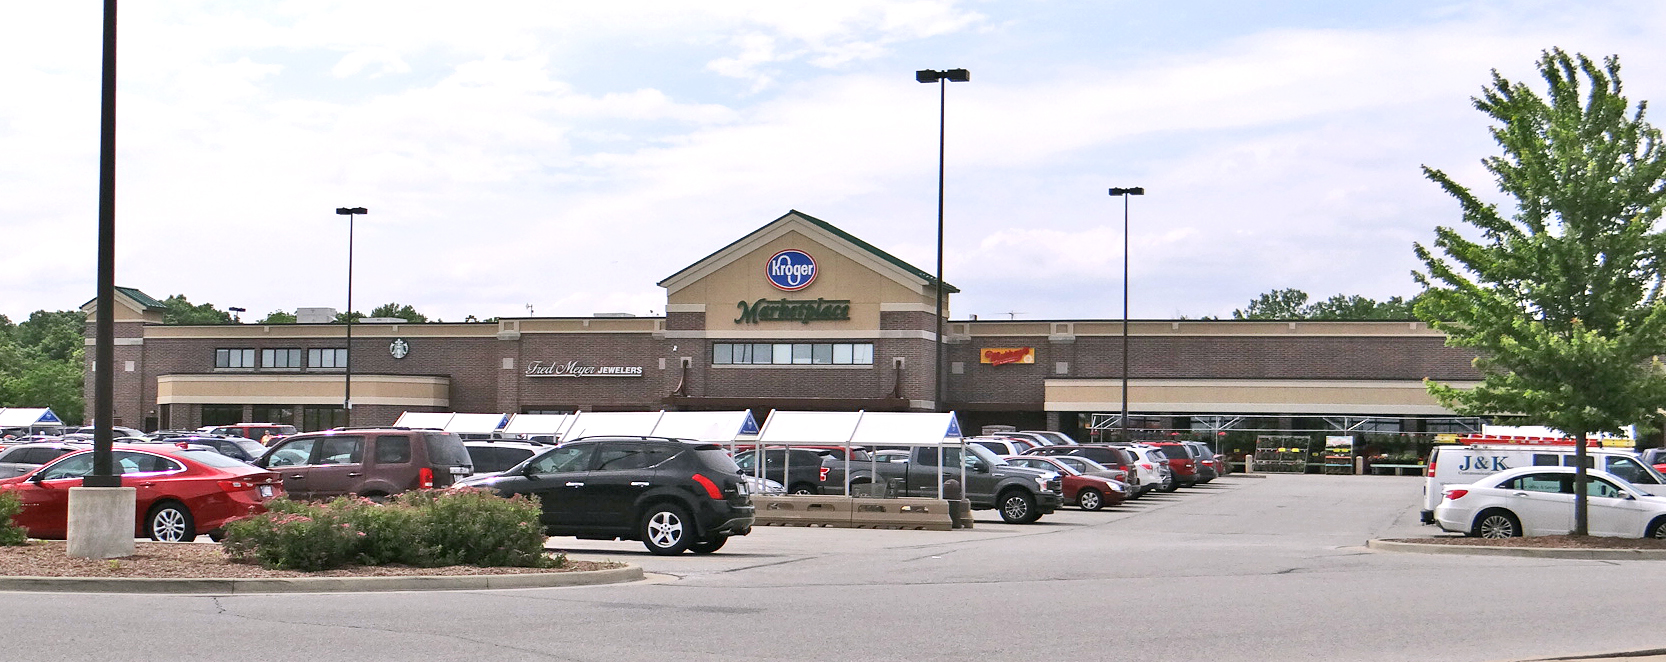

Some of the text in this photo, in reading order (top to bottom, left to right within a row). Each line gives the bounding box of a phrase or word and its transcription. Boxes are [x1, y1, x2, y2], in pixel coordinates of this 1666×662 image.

[772, 255, 814, 285] Kroger
[734, 298, 851, 324] Marketplace
[525, 360, 643, 378] Fred Meyer JEWELERS
